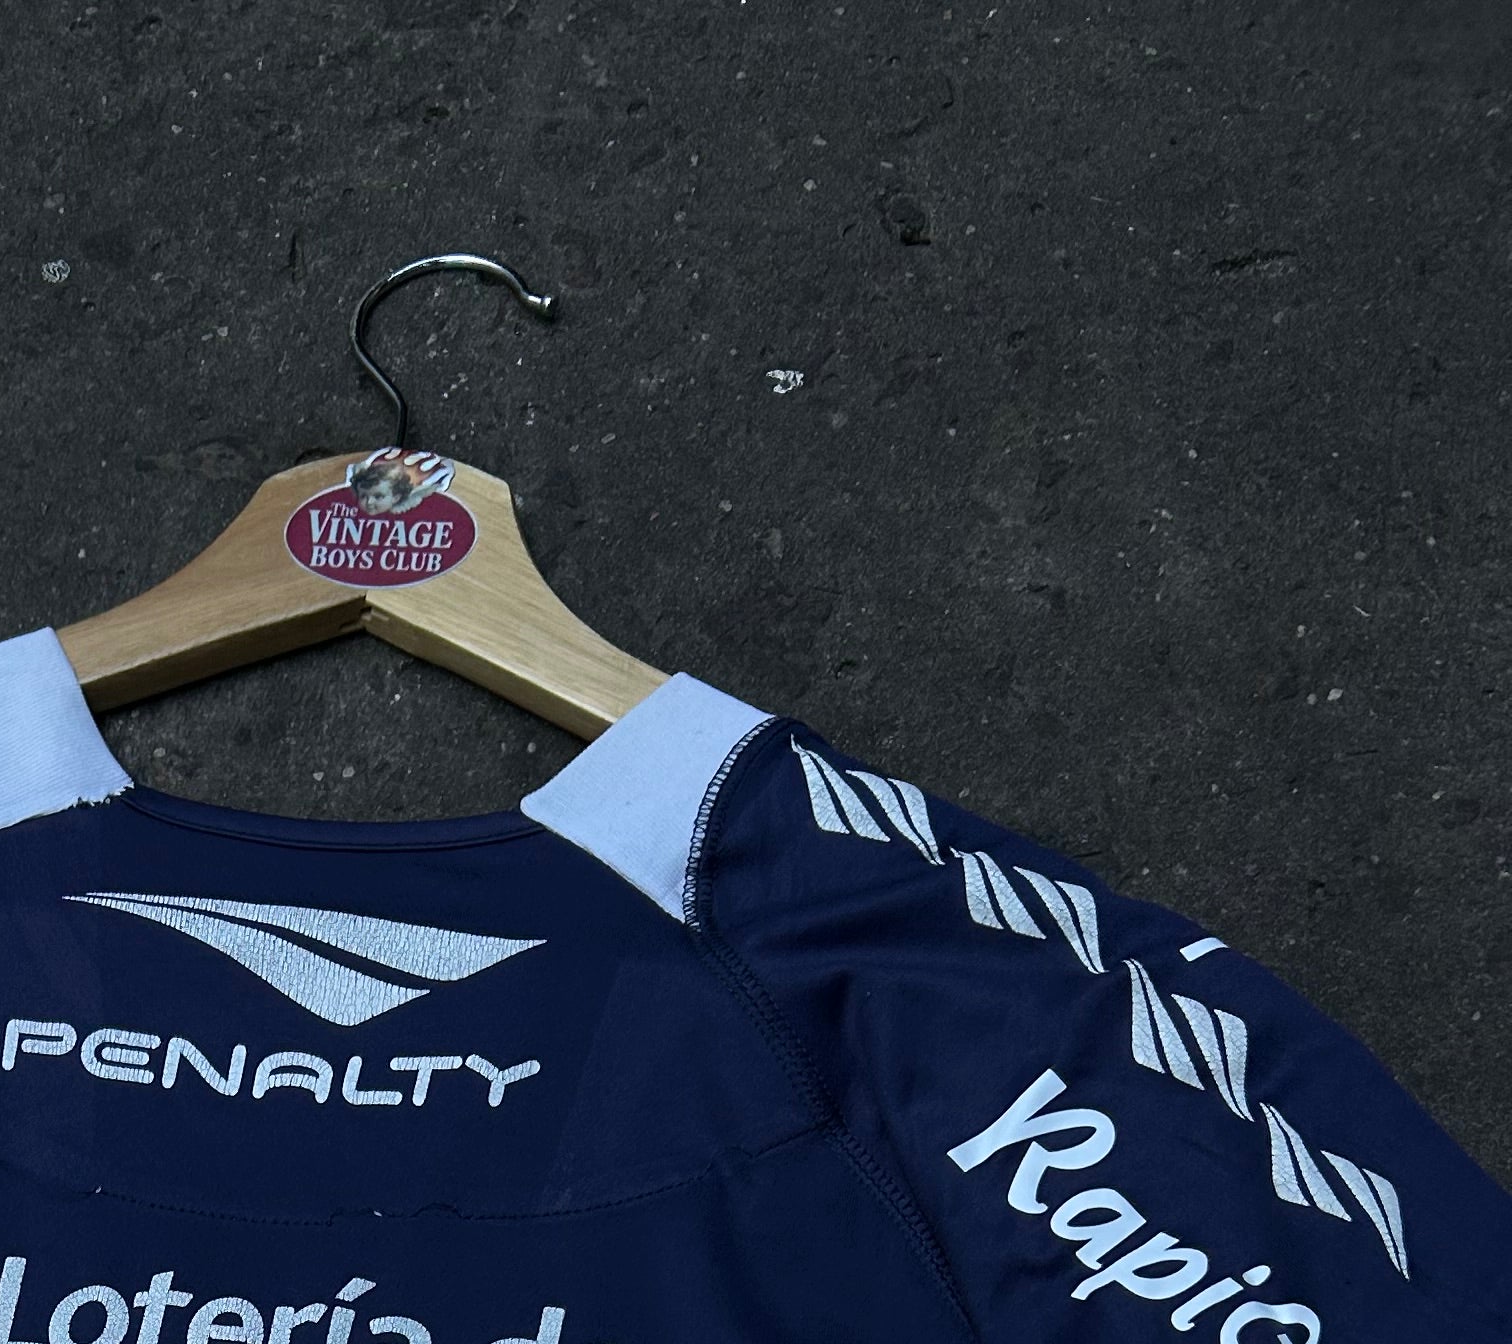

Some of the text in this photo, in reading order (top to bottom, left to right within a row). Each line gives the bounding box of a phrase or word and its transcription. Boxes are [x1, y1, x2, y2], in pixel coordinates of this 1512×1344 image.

[330, 502, 359, 518] The
[309, 509, 454, 549] VINTAGE
[309, 545, 442, 573] BOYS CLUB
[1, 1017, 542, 1108] PENALTY
